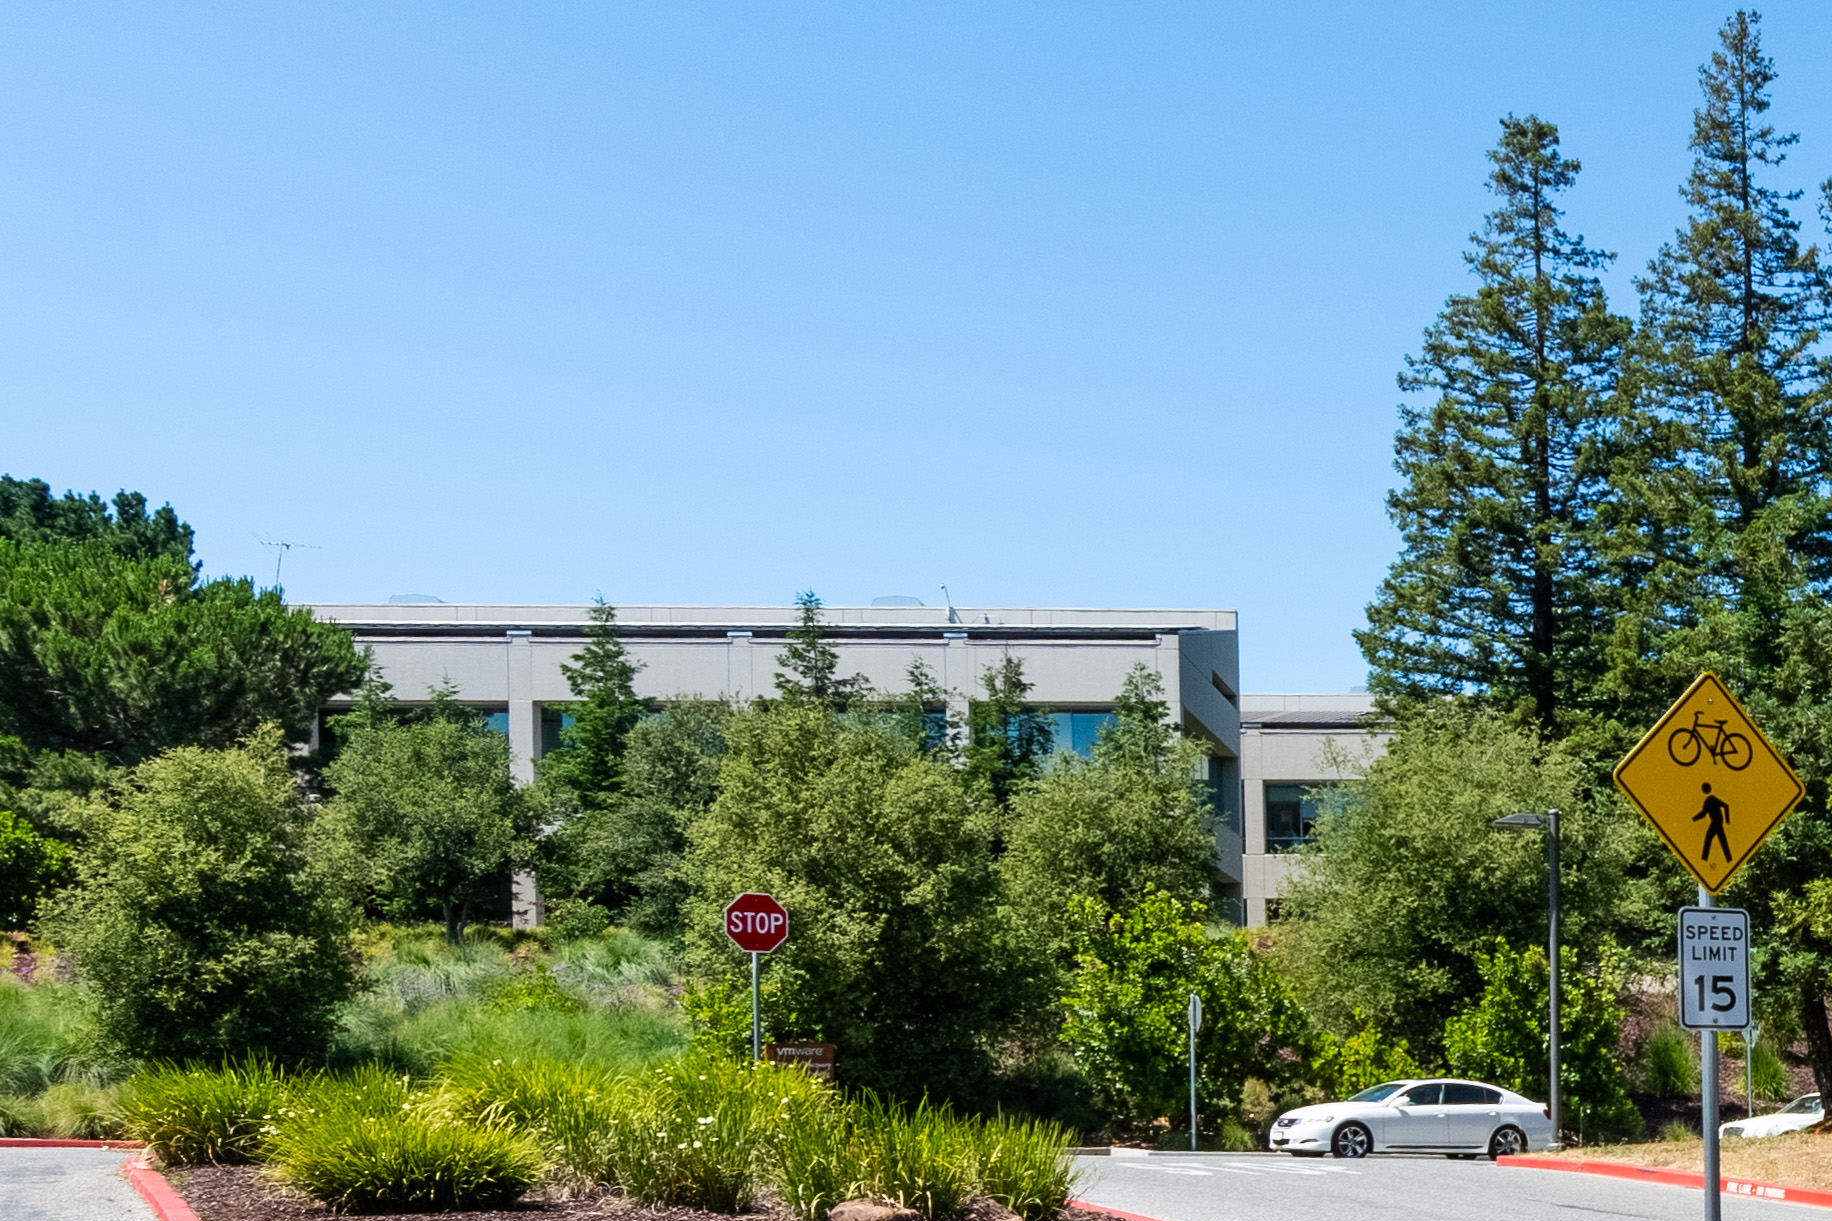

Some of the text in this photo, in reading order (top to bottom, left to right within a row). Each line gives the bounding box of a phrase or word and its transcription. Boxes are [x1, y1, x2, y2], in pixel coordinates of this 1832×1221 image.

[730, 911, 783, 934] STOP
[1686, 925, 1743, 941] SPEED
[1692, 946, 1737, 961] LIMIT
[1695, 975, 1737, 1012] 15
[776, 1047, 824, 1056] vmware
